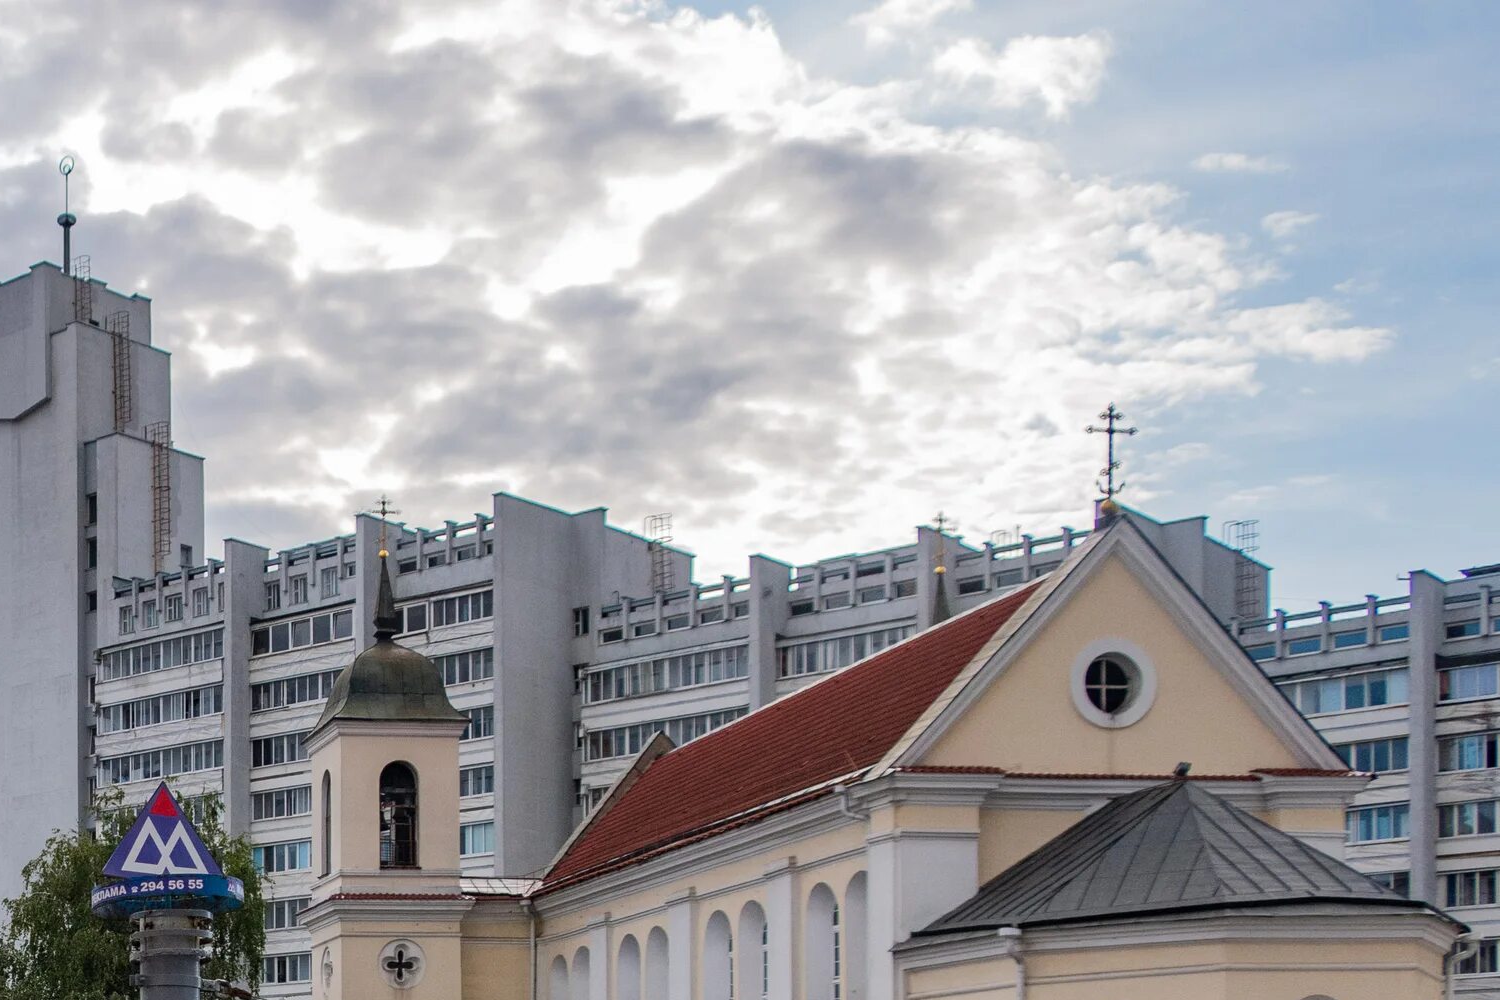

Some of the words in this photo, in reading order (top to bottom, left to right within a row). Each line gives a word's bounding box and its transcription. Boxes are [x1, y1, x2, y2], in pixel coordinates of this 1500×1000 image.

[140, 881, 164, 892] 294
[168, 880, 184, 890] 56
[188, 879, 203, 889] 55
